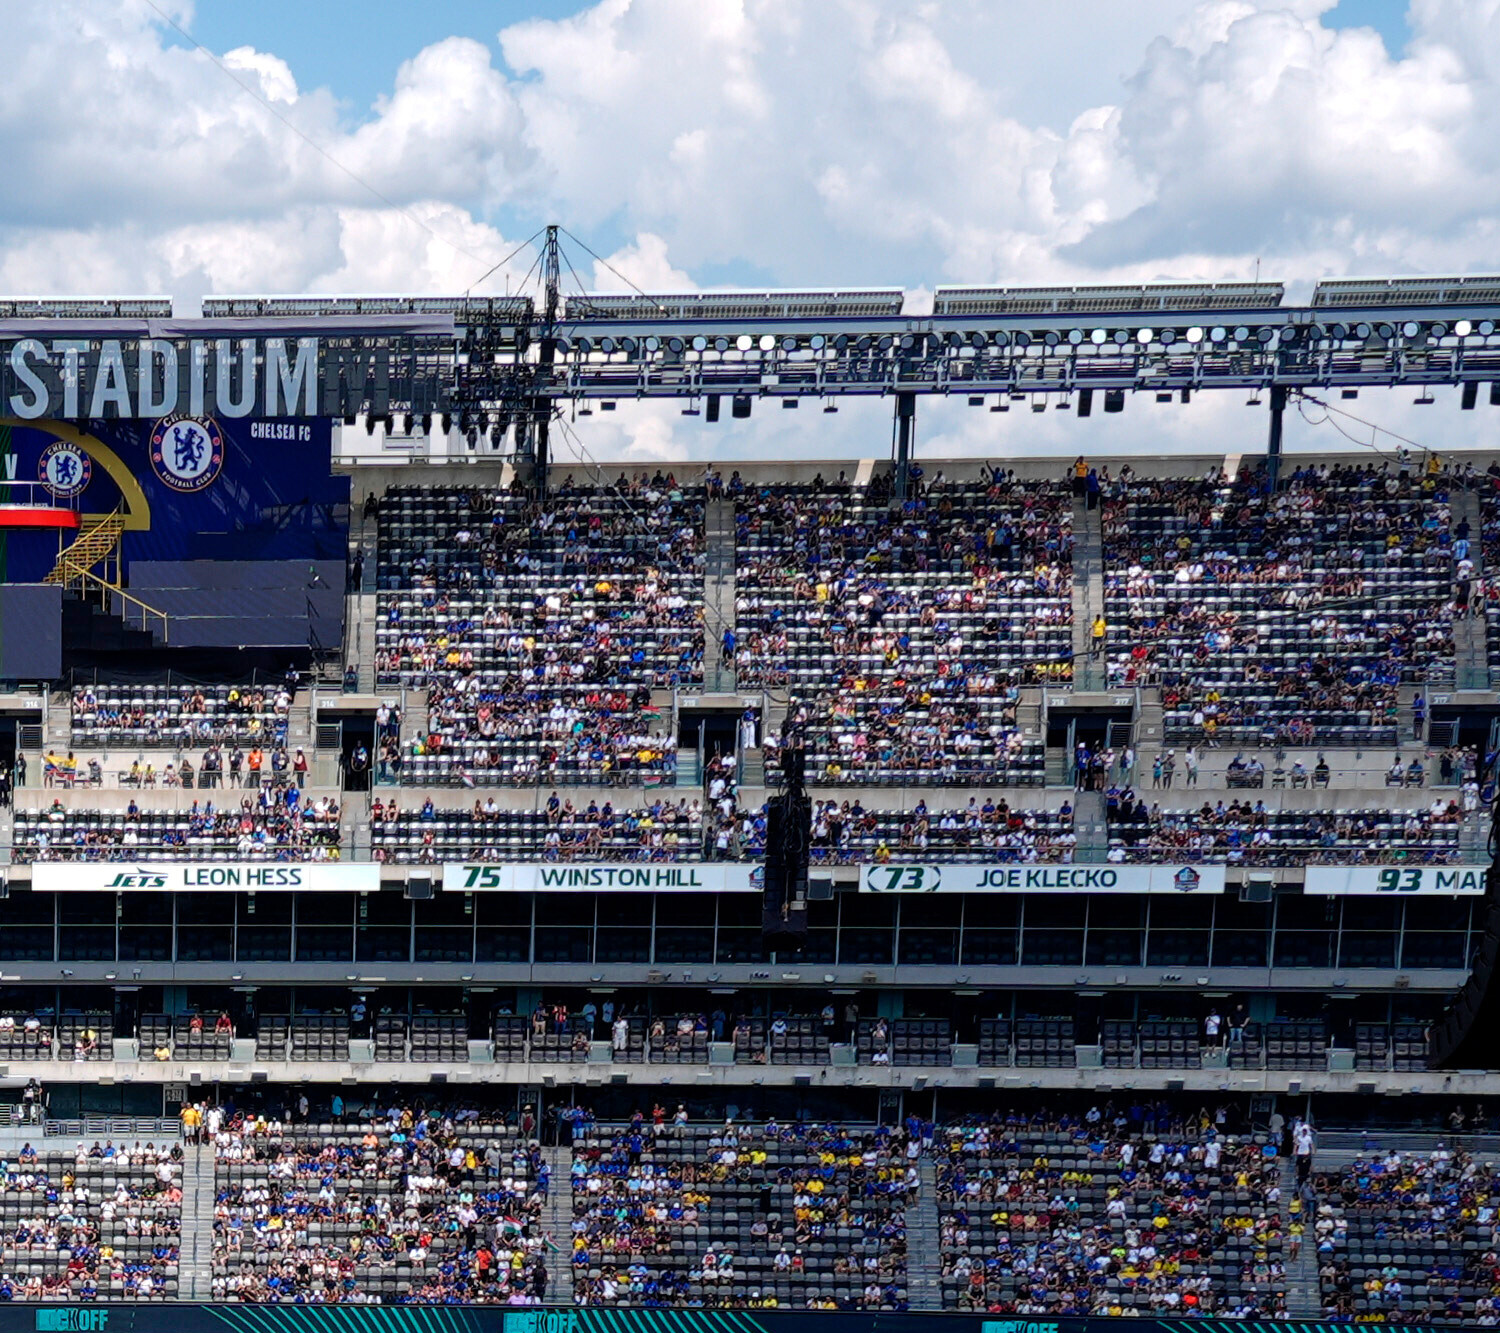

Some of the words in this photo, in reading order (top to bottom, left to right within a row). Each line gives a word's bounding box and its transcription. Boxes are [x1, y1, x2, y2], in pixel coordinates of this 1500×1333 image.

[9, 338, 319, 419] STADIUM
[251, 422, 296, 440] CHELSEA
[298, 425, 312, 441] FC
[4, 453, 18, 480] V
[183, 868, 241, 886] LEON
[247, 868, 302, 886] HESS
[462, 866, 502, 888] 75
[540, 868, 651, 887] WINSTON
[656, 869, 703, 887] HILL
[884, 866, 925, 889] 73
[976, 870, 1021, 888] JOE
[1027, 870, 1117, 888] KLECKO
[1376, 868, 1423, 892] 93
[78, 1309, 109, 1331] OFF
